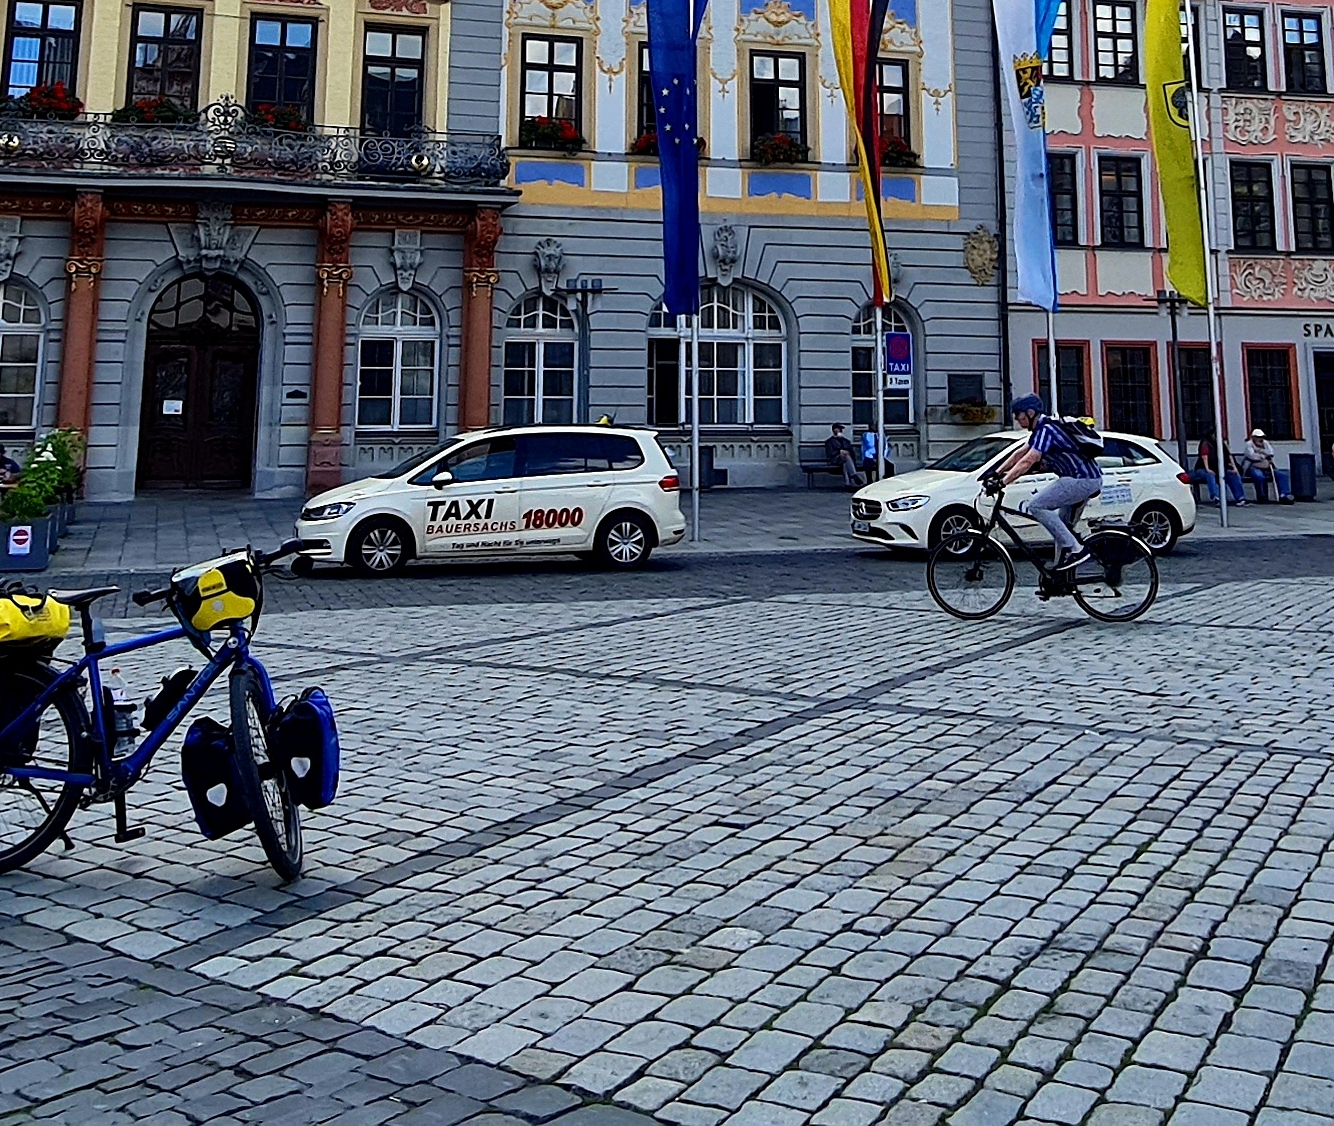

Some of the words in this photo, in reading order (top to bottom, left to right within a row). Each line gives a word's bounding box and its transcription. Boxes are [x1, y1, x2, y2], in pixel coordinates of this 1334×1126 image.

[889, 363, 909, 372] TAXI
[427, 498, 495, 522] TAXI
[522, 507, 584, 529] 18000
[426, 520, 516, 535] BAUERSACHS
